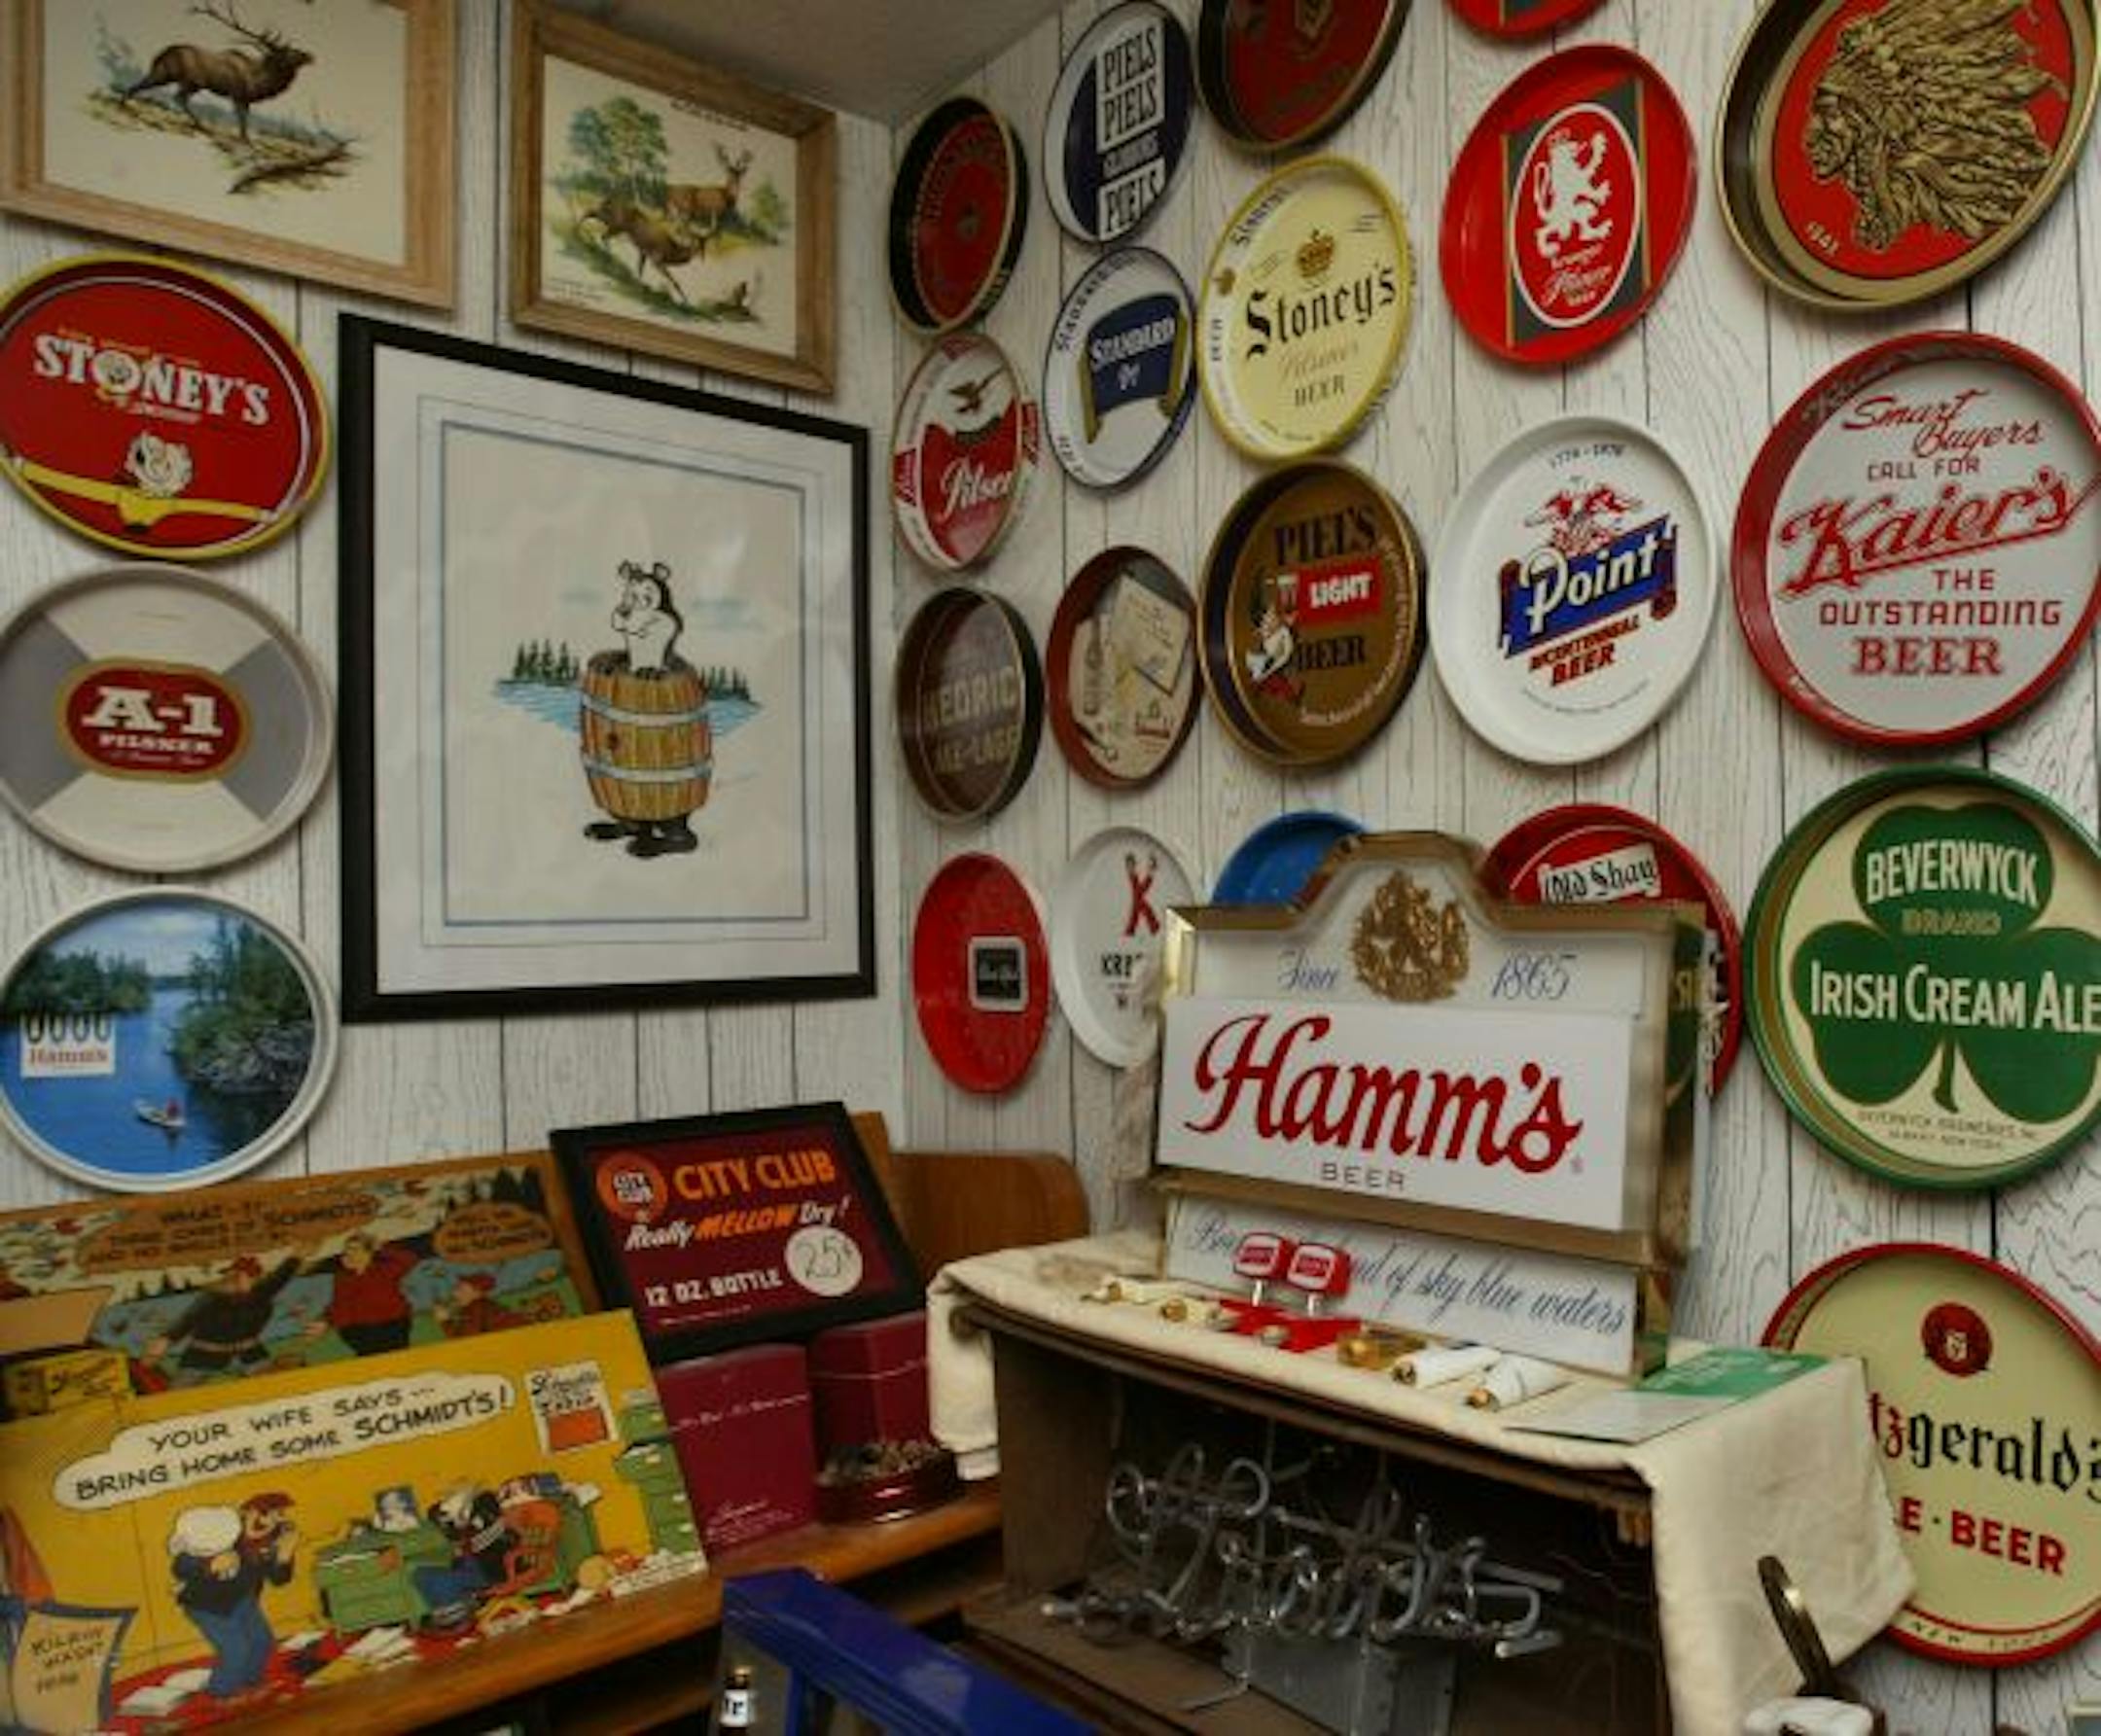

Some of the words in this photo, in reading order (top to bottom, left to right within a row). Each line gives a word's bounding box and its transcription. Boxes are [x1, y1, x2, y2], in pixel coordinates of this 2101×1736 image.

[1103, 27, 1157, 94] PIELS
[1104, 77, 1157, 143] PIELS
[1246, 261, 1396, 360] Stoney's
[1090, 318, 1175, 372] STANDARD
[34, 334, 270, 426] STONEY'S
[1841, 389, 1991, 431] Smart
[1912, 418, 2043, 461] Buyers
[1867, 460, 1917, 481] CALL
[1934, 456, 1980, 478] FOR
[1778, 465, 2070, 588] Kaier's
[1310, 572, 1372, 608] LIGHT
[1517, 531, 1661, 634] Point
[1931, 568, 1996, 591] THE
[1819, 599, 2062, 626] OUTSTANDING
[1550, 642, 1616, 687] BEER
[1852, 635, 2004, 676] BEER
[81, 686, 224, 736] A-1
[98, 733, 215, 755] PILSNER
[1546, 871, 1588, 903] Old
[1590, 856, 1657, 898] Shay
[1866, 839, 2038, 907] BEVERWYCK
[1491, 951, 1578, 1000] 1865
[1809, 959, 1898, 1021] IRISH
[1904, 963, 2026, 1029] CREAM
[2033, 970, 2101, 1034] ALE
[1185, 1012, 1584, 1174] Hamm's
[673, 1157, 751, 1201] CITY
[755, 1149, 836, 1189] CLUB
[1321, 1163, 1404, 1190] BEER
[623, 1219, 695, 1252] Really
[694, 1203, 801, 1240] MELLOW
[645, 1285, 670, 1307] 12
[710, 1268, 784, 1298] BOTTLE
[1416, 1252, 1465, 1324] sky
[1465, 1257, 1523, 1310] blue
[1528, 1286, 1625, 1336] waters
[149, 1421, 230, 1452] YOUR
[249, 1406, 312, 1434] WIFE
[333, 1388, 403, 1417] SAYS
[76, 1463, 169, 1501] BRING
[181, 1450, 257, 1476] HOME
[268, 1430, 341, 1457] SOME
[1950, 1508, 2067, 1576] BEER
